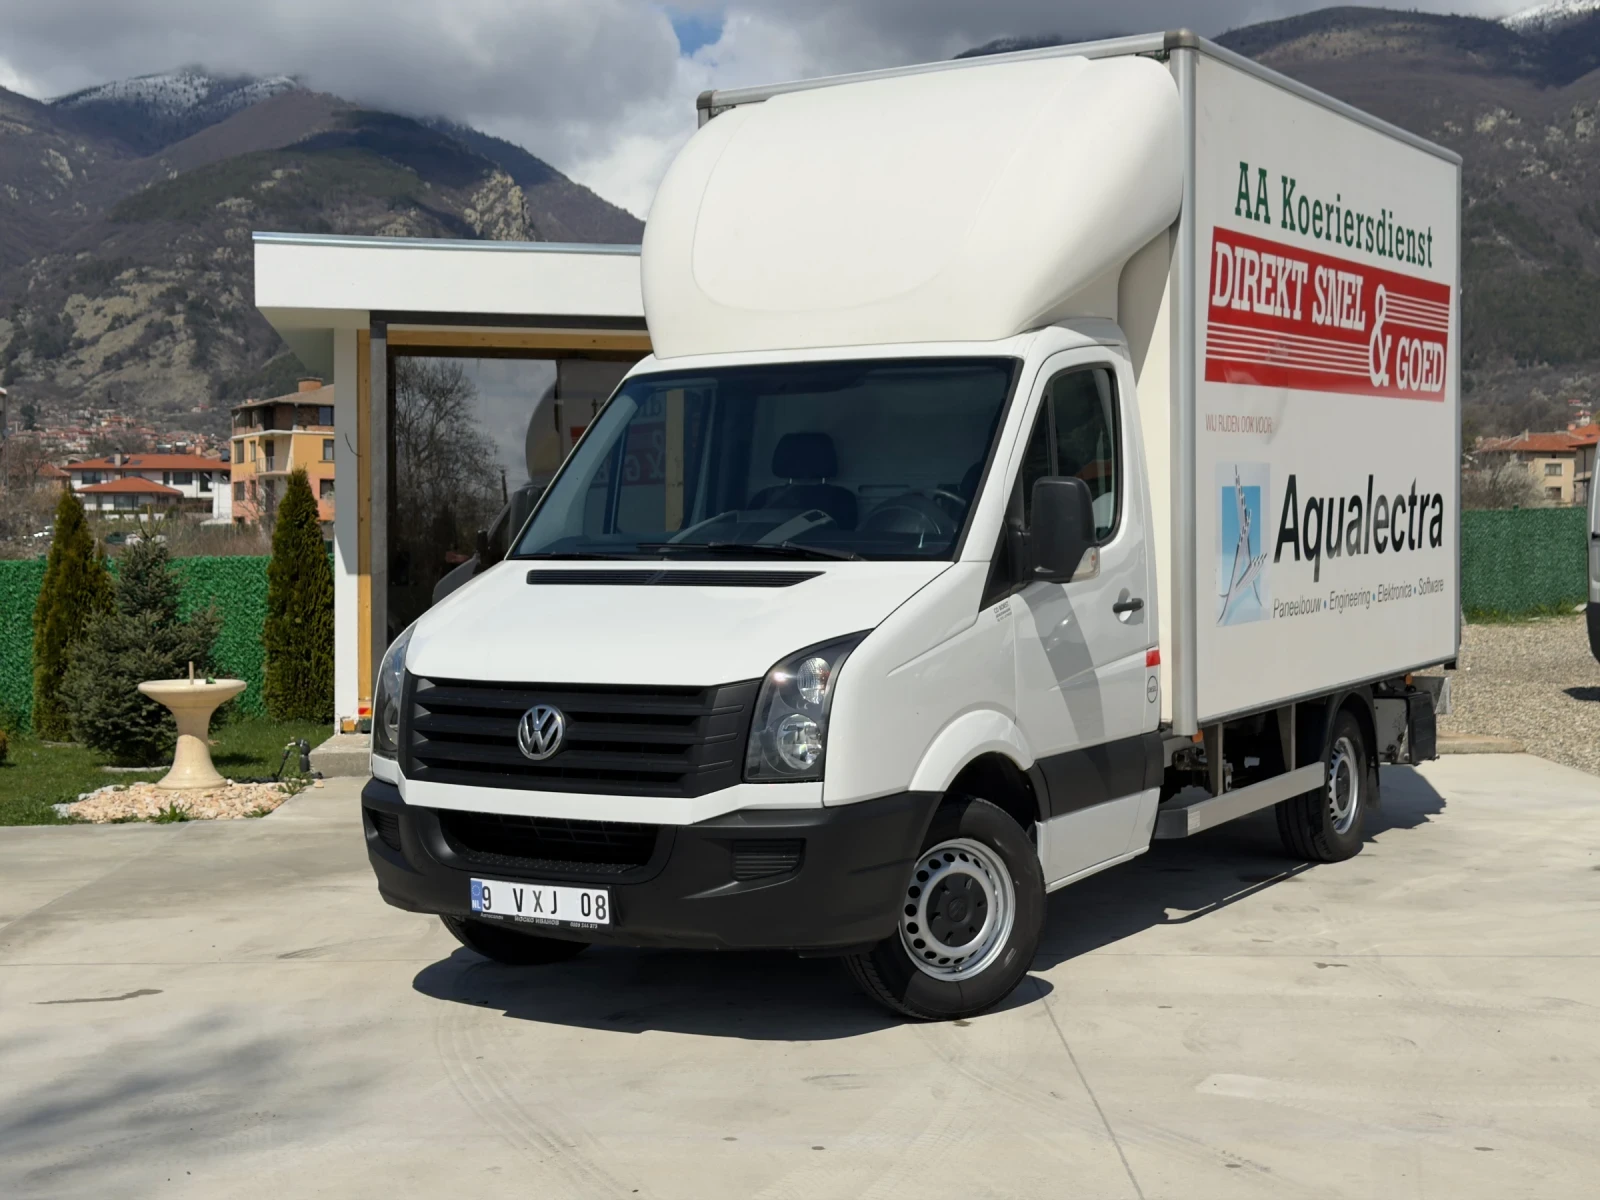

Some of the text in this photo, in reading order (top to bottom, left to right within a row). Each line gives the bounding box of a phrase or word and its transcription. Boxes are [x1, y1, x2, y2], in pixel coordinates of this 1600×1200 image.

[1234, 161, 1433, 269] AA Koeriersdienst
[1212, 241, 1366, 332] DIREKT SNEL
[1369, 284, 1445, 393] & GOED
[1241, 416, 1254, 433] OOK
[1273, 474, 1443, 583] Aqualectra
[1273, 577, 1444, 619] Paneelbouw Engineering Elektronica Software
[472, 899, 481, 909] NL
[482, 886, 607, 920] 9 VXJ 08
